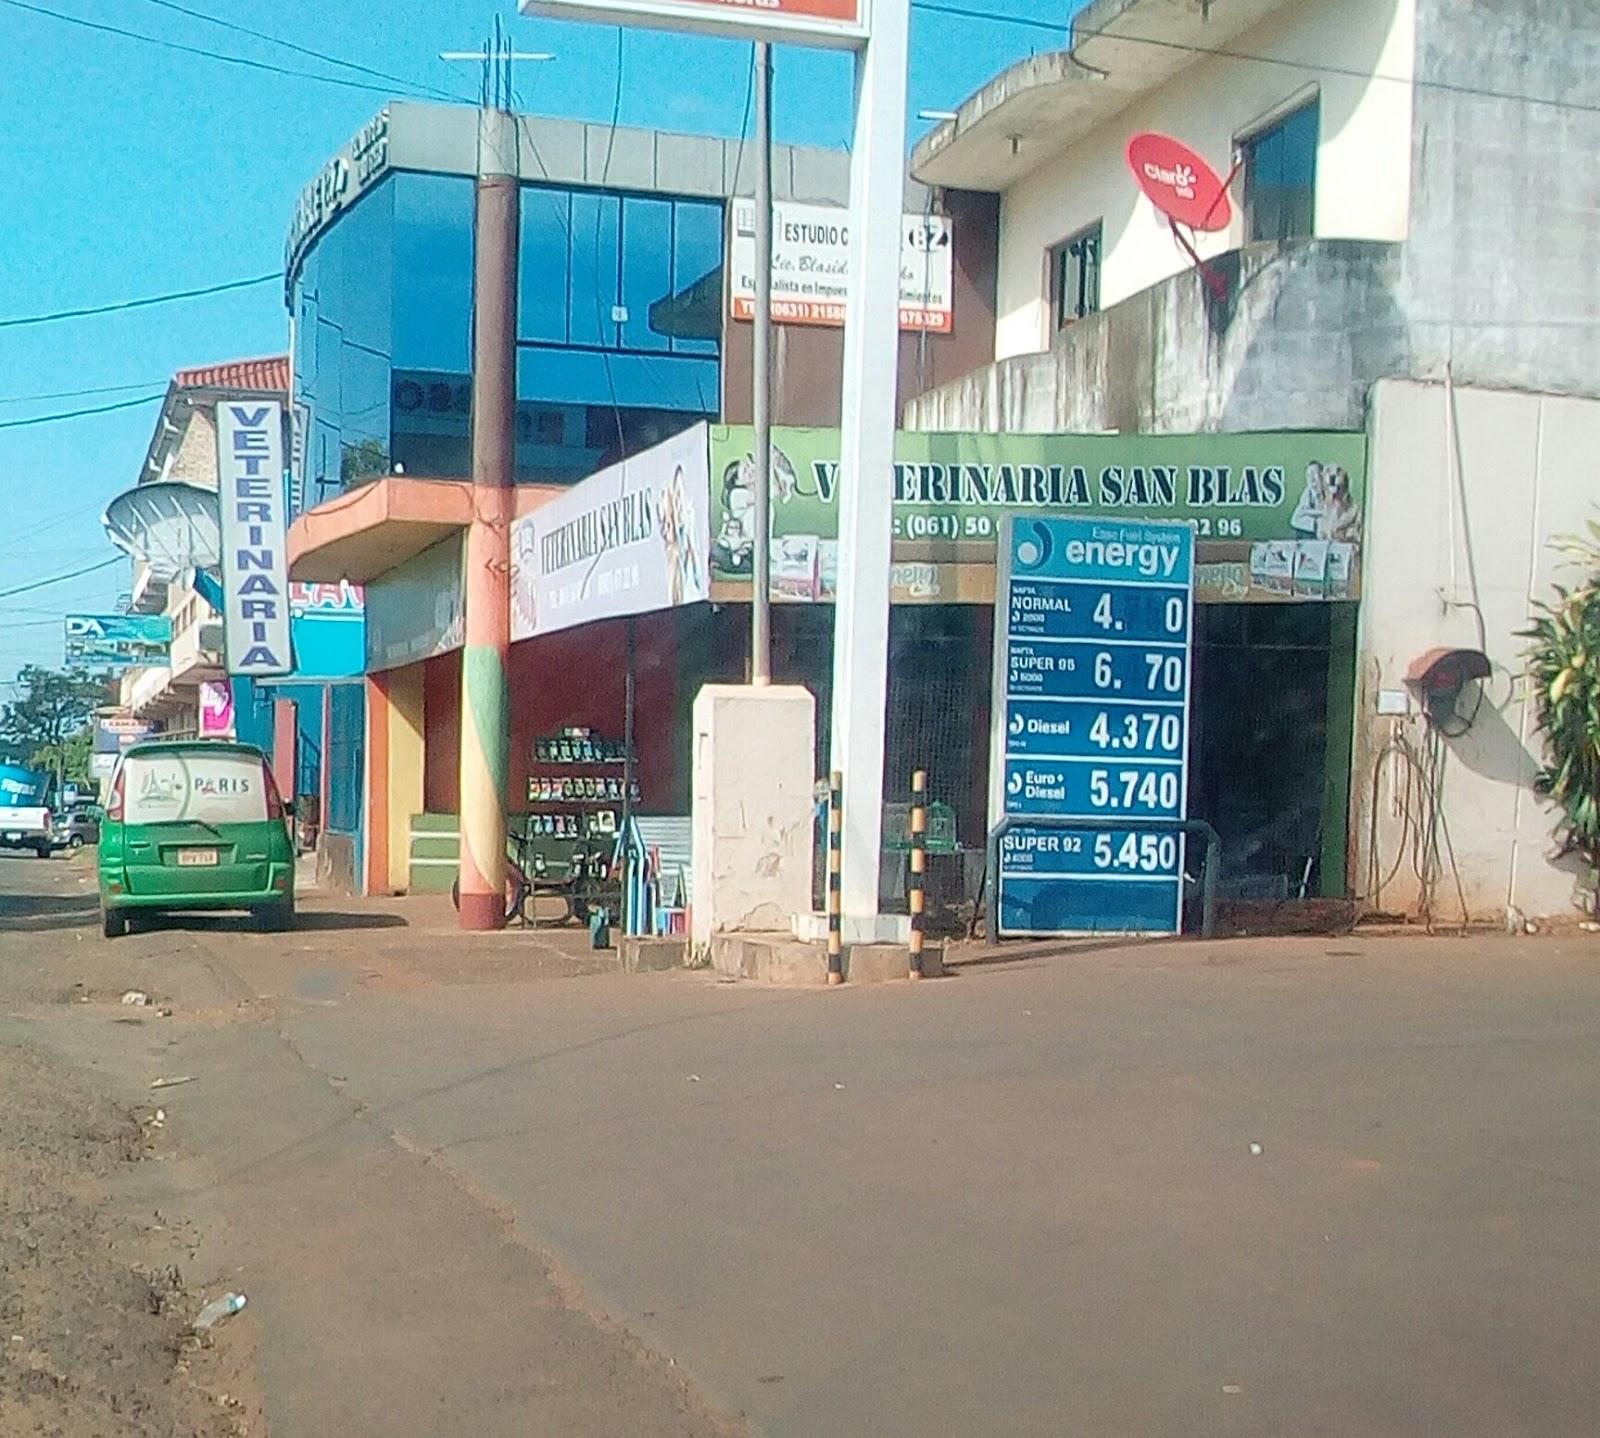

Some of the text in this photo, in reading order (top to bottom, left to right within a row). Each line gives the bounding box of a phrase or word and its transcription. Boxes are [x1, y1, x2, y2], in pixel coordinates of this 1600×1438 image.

[785, 223, 838, 246] ESTUDIO
[813, 460, 1285, 507] VERINARIA SAN BLAS
[230, 407, 281, 667] VETERINARIA
[907, 514, 958, 539] (061)
[1218, 518, 1242, 536] 96
[1066, 538, 1180, 577] energy
[1012, 596, 1071, 612] NORMAL
[1165, 597, 1183, 632] 0
[1010, 656, 1054, 671] SUPER
[1145, 653, 1182, 692] 70
[1027, 718, 1070, 735] Diesel
[1089, 711, 1180, 751] 4.370
[194, 777, 250, 795] PARIS
[1025, 786, 1065, 800] Diesel
[1090, 769, 1178, 809] 5.740
[1004, 836, 1059, 852] SUPER
[1094, 832, 1177, 872] 5.450
